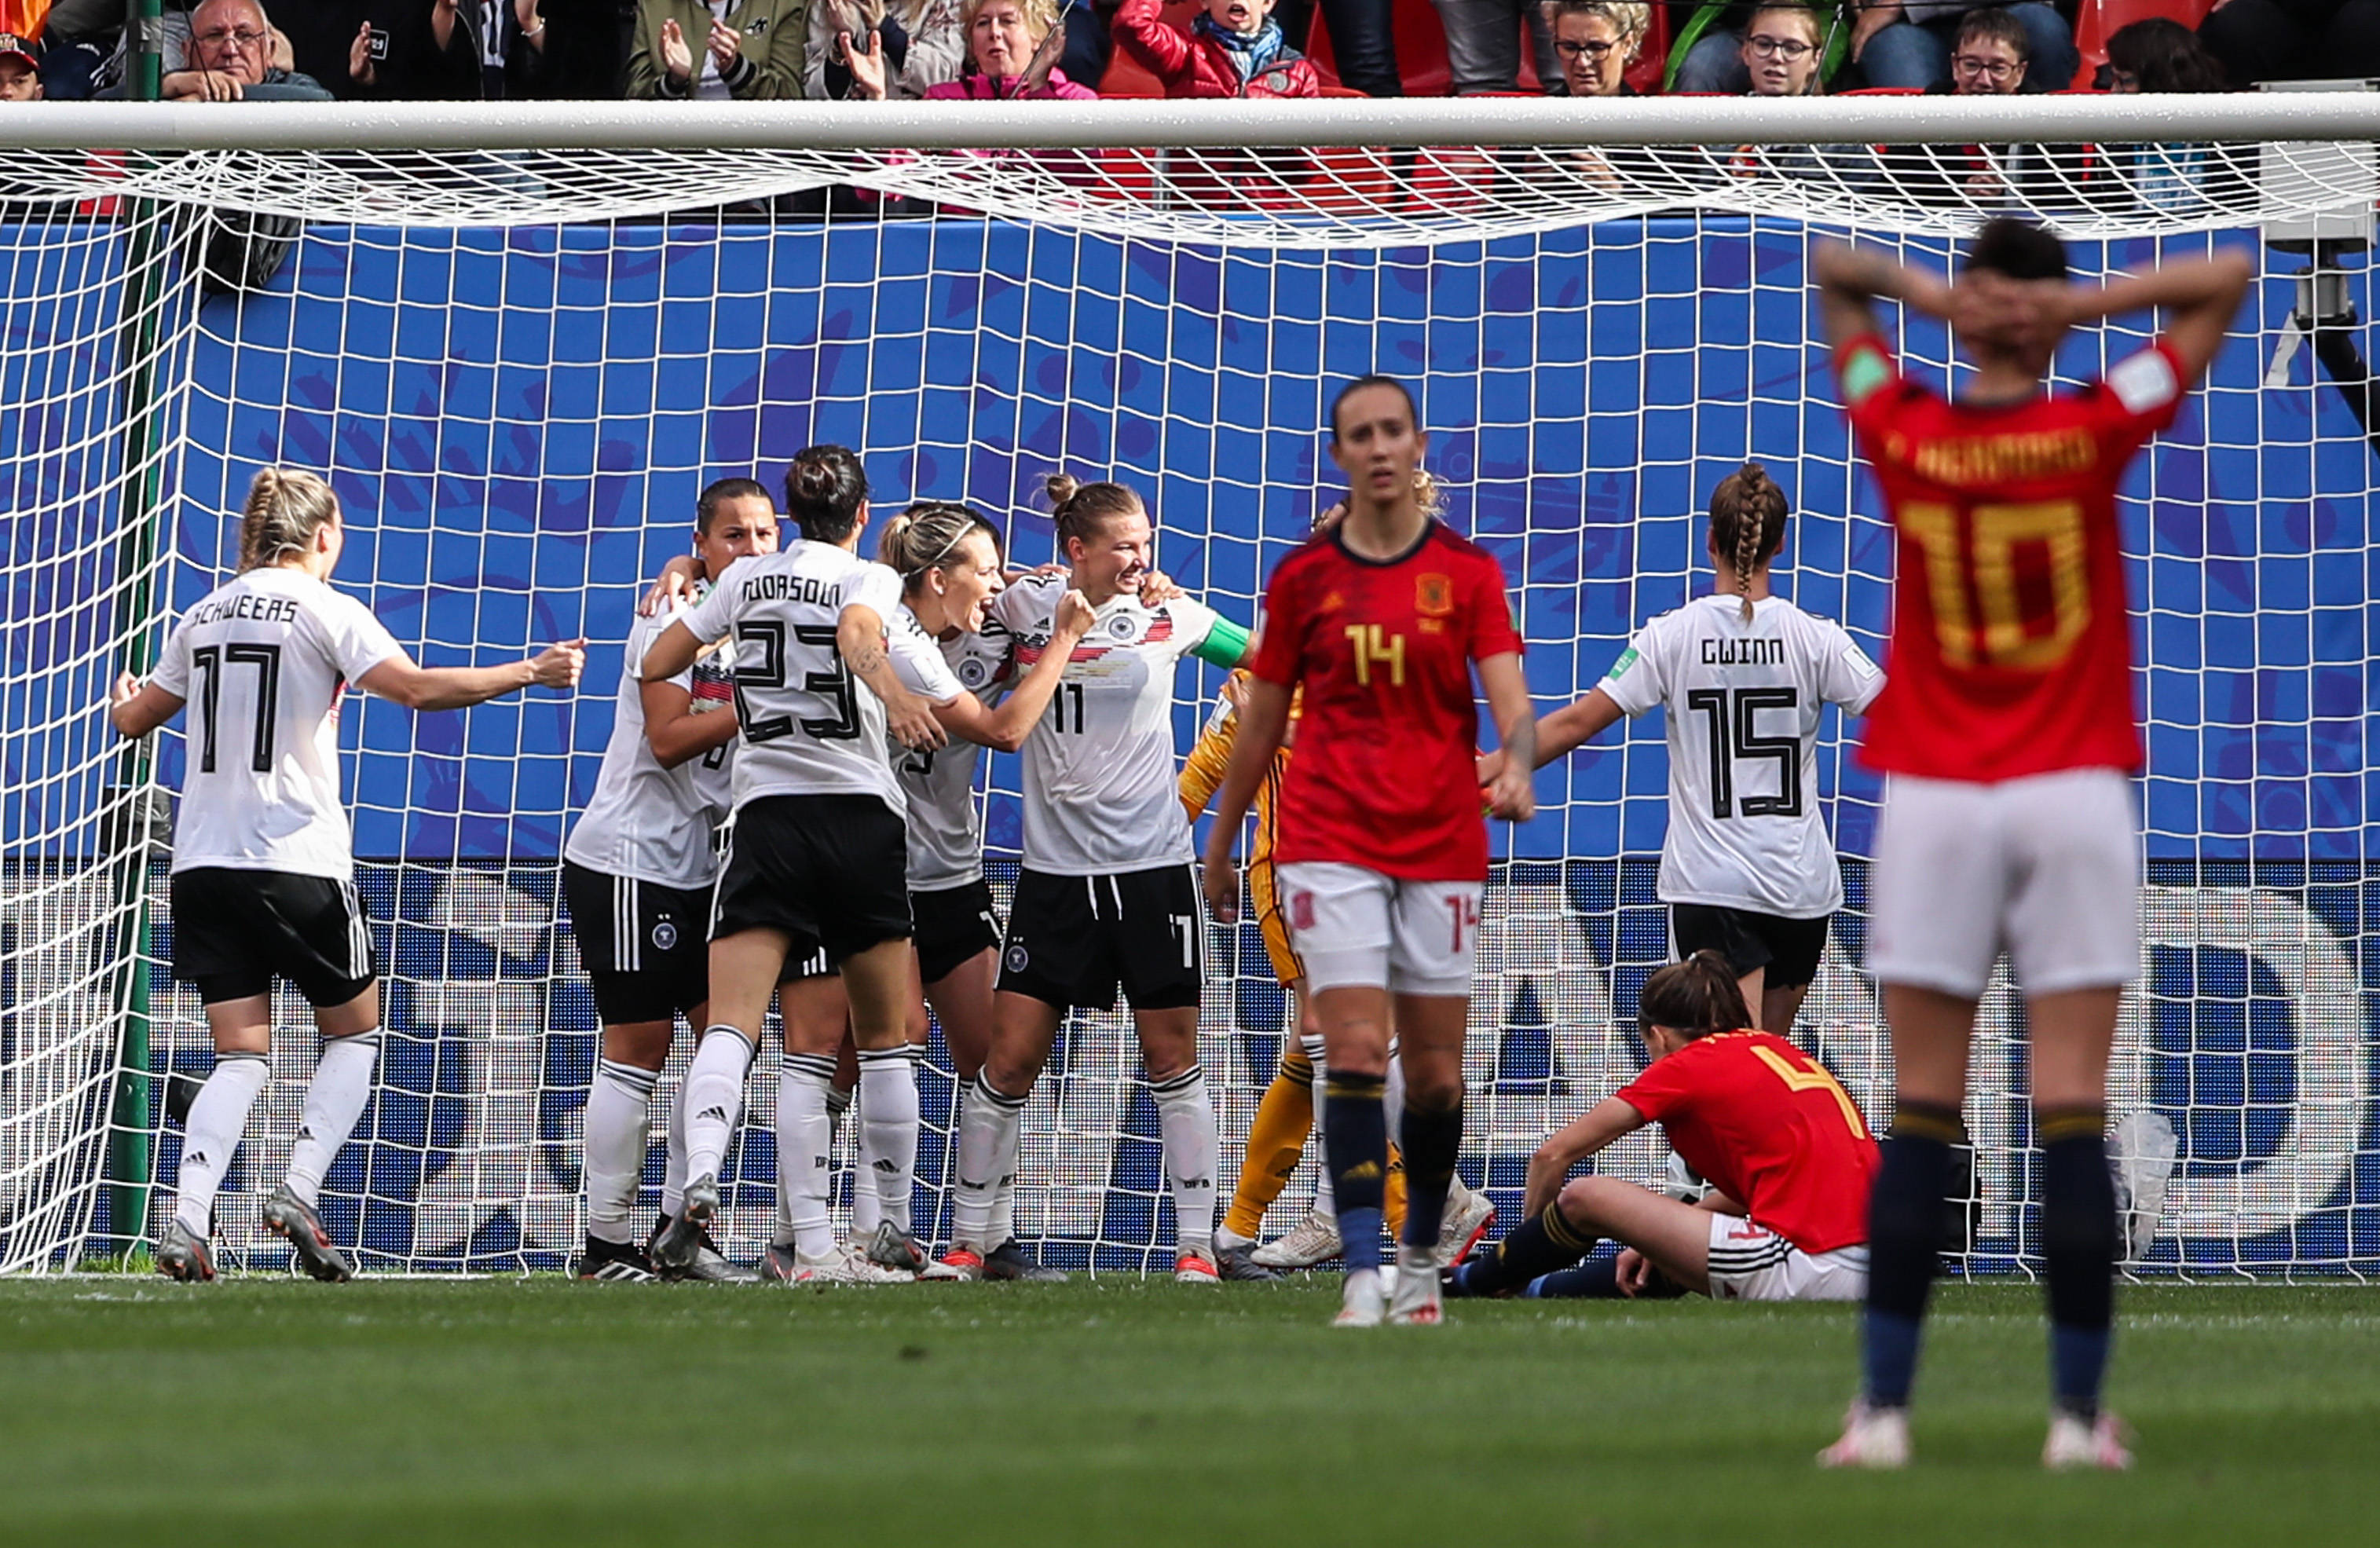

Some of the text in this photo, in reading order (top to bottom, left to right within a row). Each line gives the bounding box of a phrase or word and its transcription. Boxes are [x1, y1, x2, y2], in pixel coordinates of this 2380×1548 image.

[1898, 501, 2093, 672] 10
[192, 642, 280, 773] 17
[734, 621, 860, 743] 23
[1345, 624, 1405, 686] 14
[1701, 639, 1784, 664] GWINN
[1687, 687, 1801, 818] 15
[1749, 1045, 1866, 1140] 4
